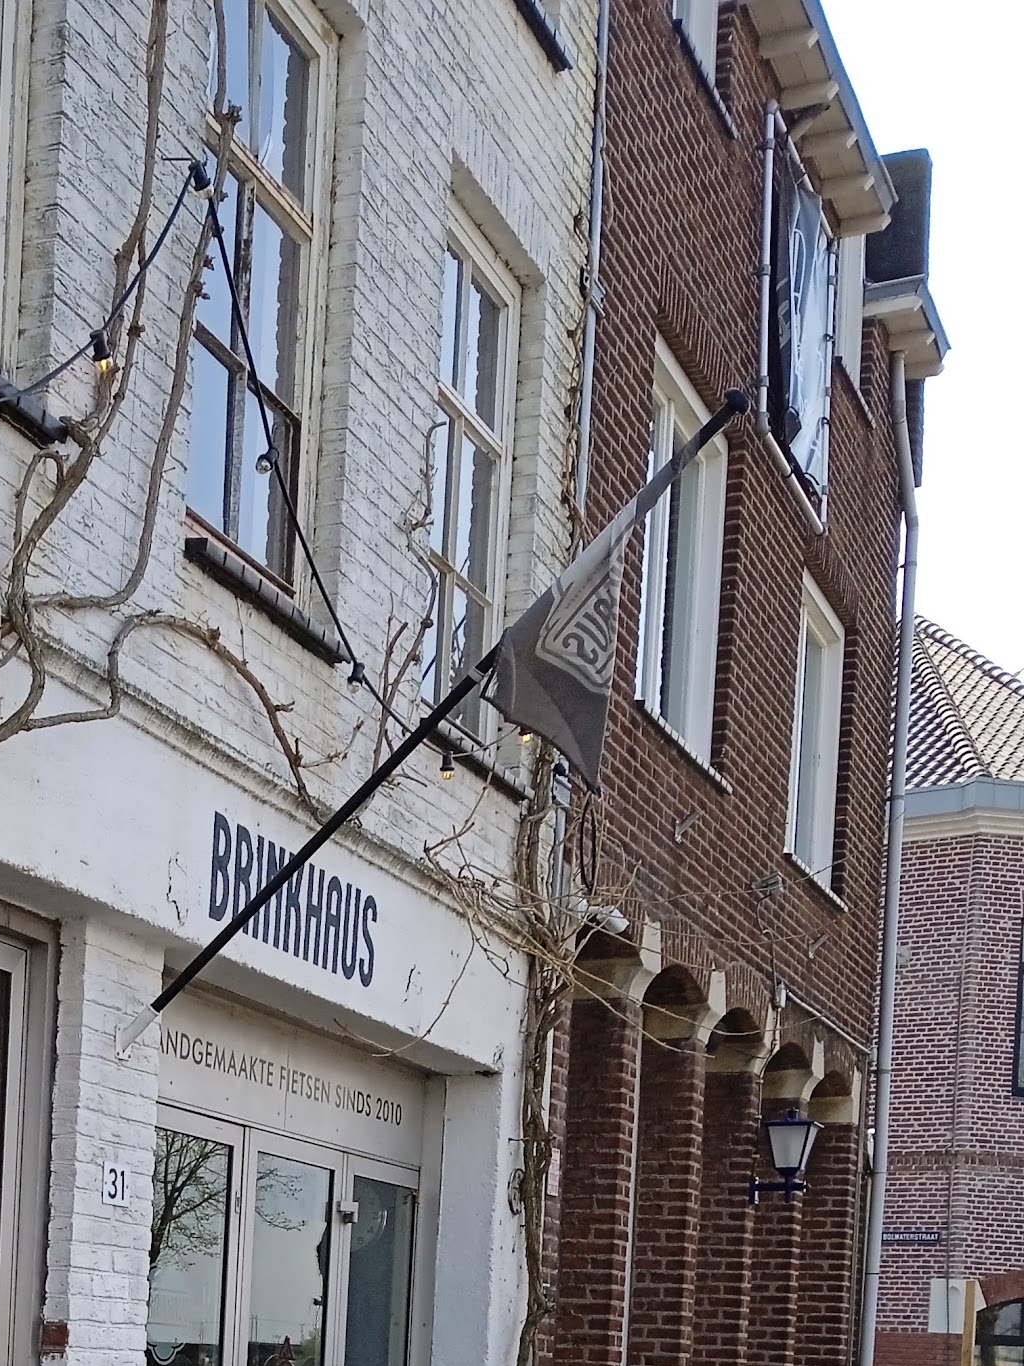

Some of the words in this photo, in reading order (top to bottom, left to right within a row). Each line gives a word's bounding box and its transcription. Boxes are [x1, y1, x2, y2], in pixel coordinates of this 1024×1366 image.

[208, 811, 378, 988] BRINKHAUS
[159, 1023, 274, 1087] ANDGEMAAKTE
[279, 1065, 331, 1105] FIETSEN
[335, 1084, 372, 1117] SINDS
[376, 1097, 402, 1126] 2010
[108, 1168, 125, 1201] 31
